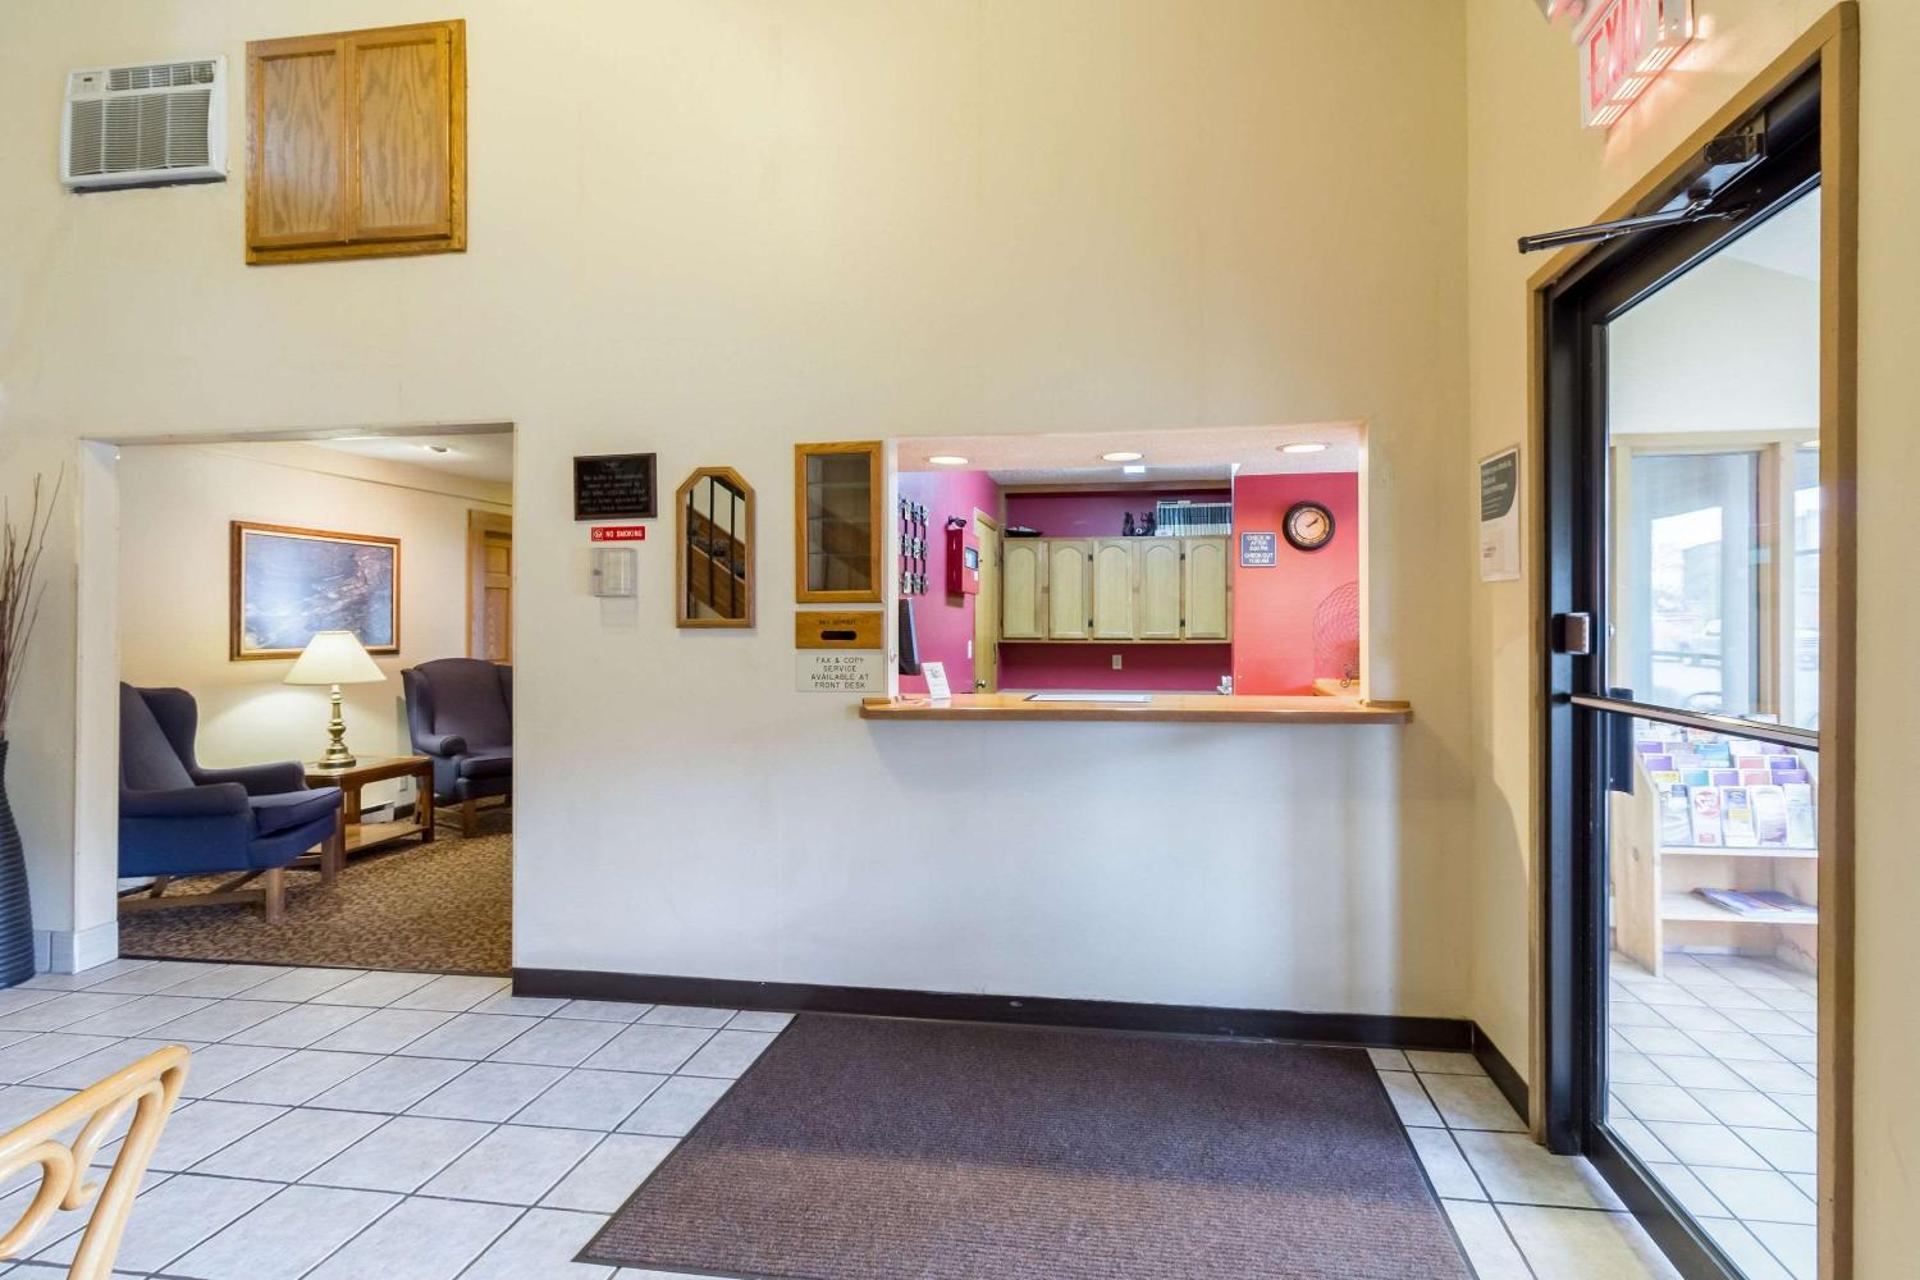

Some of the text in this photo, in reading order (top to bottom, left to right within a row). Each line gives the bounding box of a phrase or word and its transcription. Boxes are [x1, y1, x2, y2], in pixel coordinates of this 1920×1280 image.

[605, 530, 643, 538] NO SMOKING
[816, 656, 832, 664] FAX
[843, 656, 864, 664] COPY
[811, 673, 856, 681] AVAILABLE
[814, 681, 866, 689] FRONT DESK
